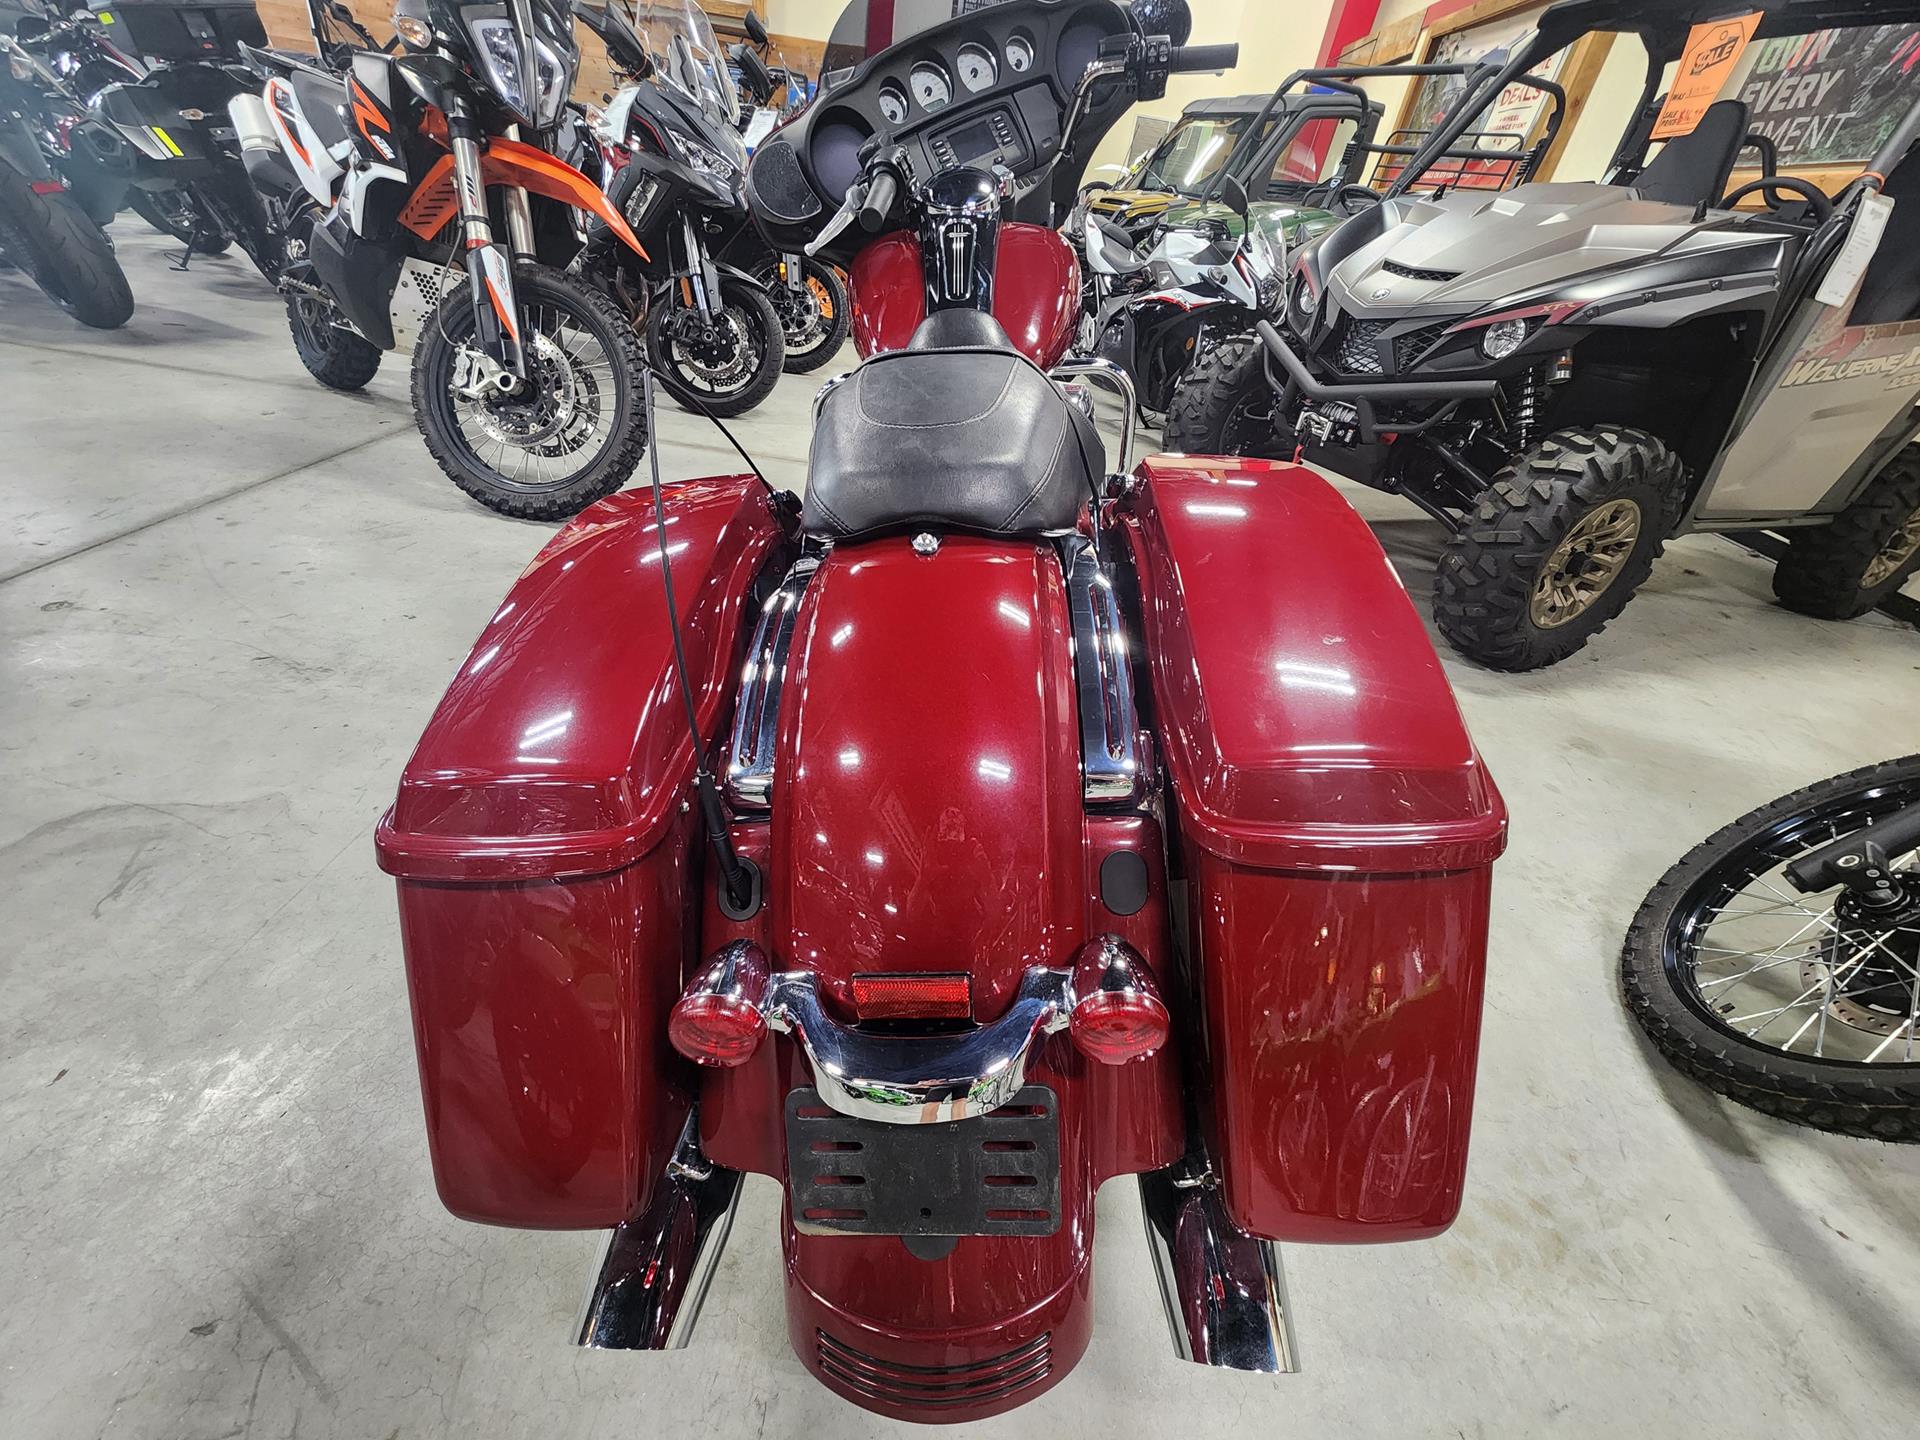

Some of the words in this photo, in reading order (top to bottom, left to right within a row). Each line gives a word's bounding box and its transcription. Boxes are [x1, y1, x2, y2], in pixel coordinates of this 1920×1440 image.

[1500, 86, 1541, 107] DEALS
[1740, 69, 1846, 114] EVERY
[1780, 353, 1905, 388] WOLVERINE
